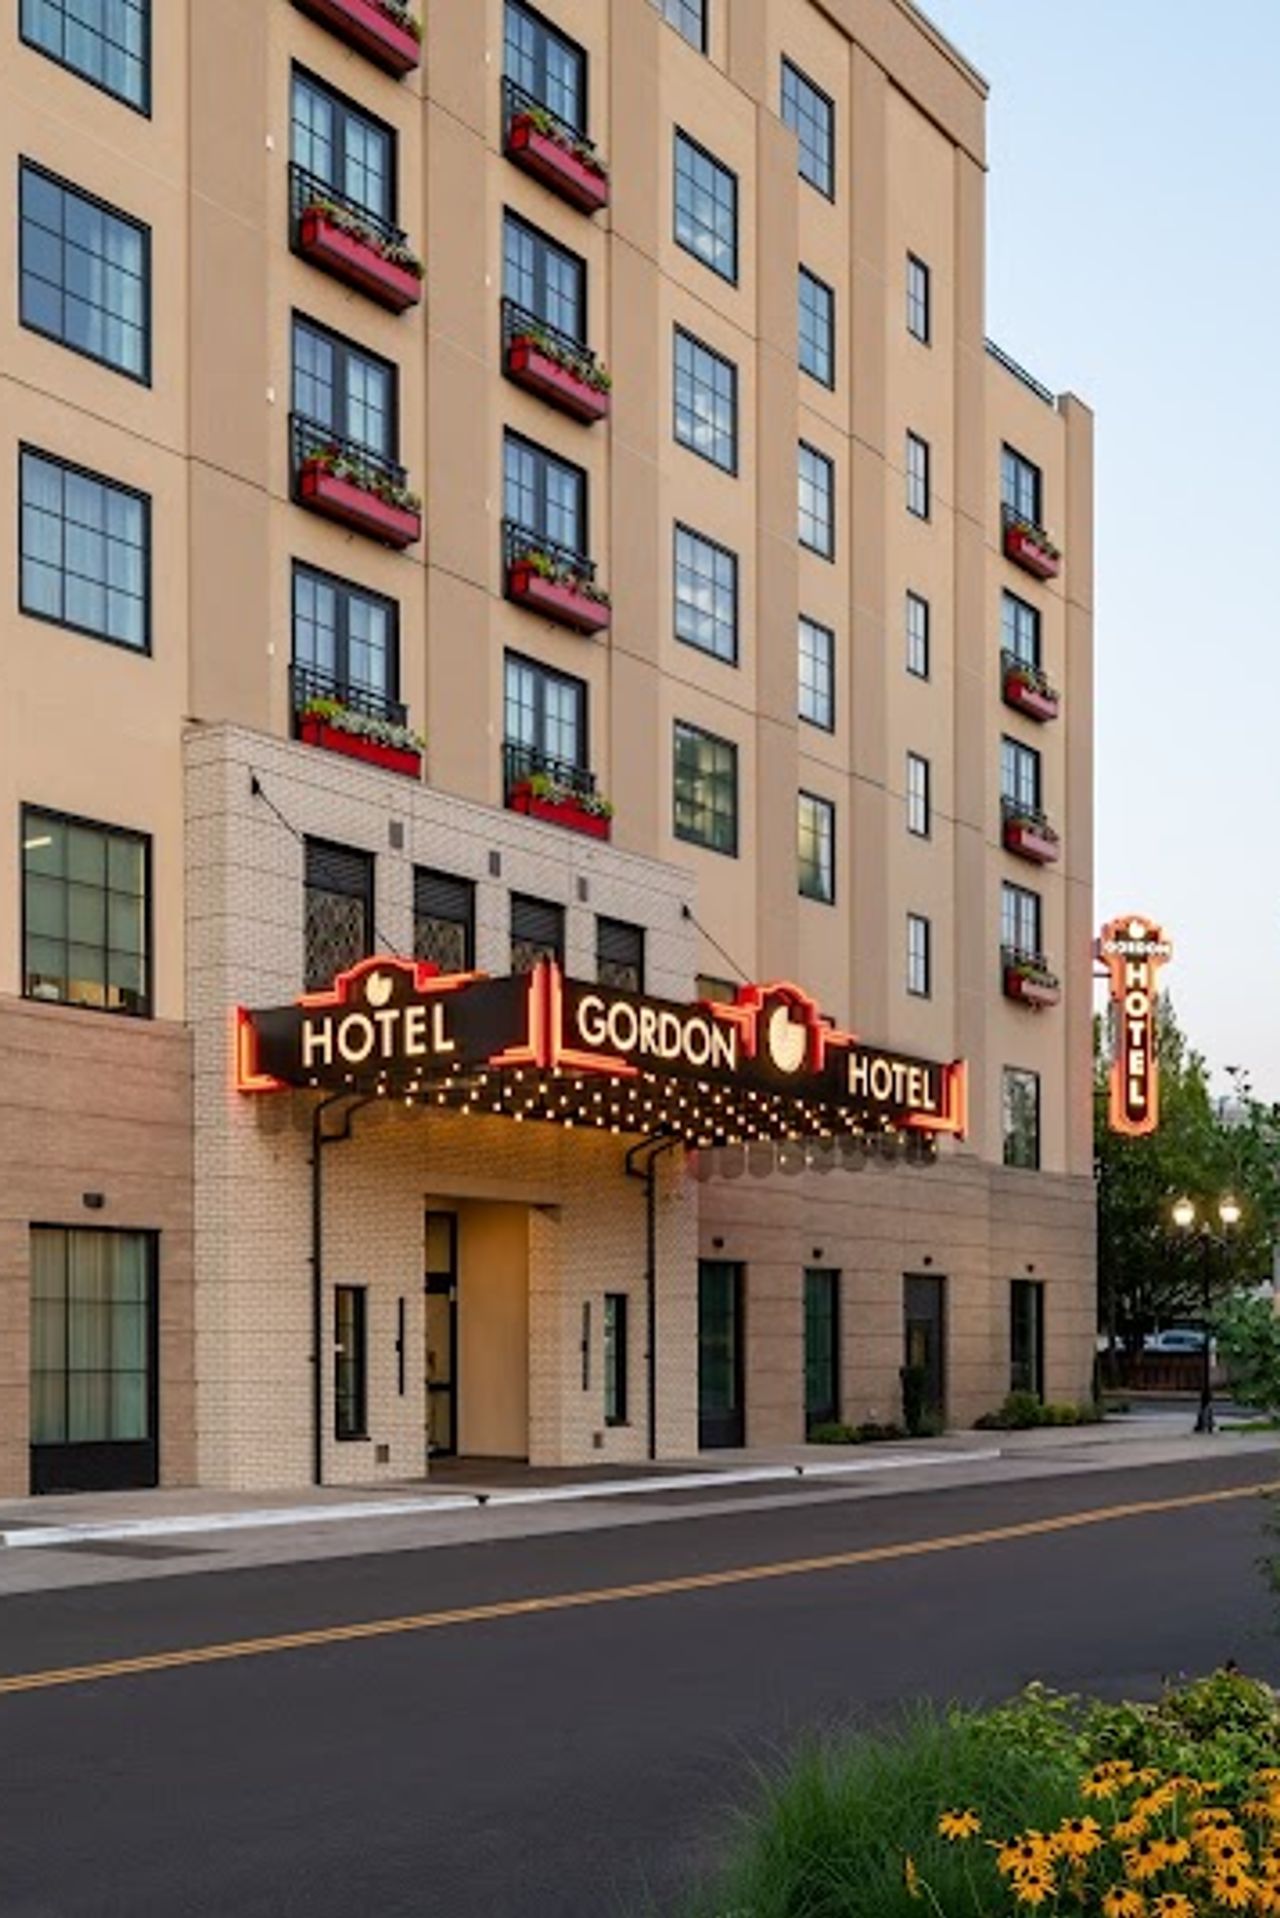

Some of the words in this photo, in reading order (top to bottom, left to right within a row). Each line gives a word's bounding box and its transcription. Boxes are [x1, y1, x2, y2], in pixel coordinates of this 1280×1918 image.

[303, 1003, 455, 1067] HOTEL
[577, 995, 738, 1072] GORDON
[848, 1053, 937, 1110] HOTEL
[1125, 963, 1149, 1106] HOTEL
